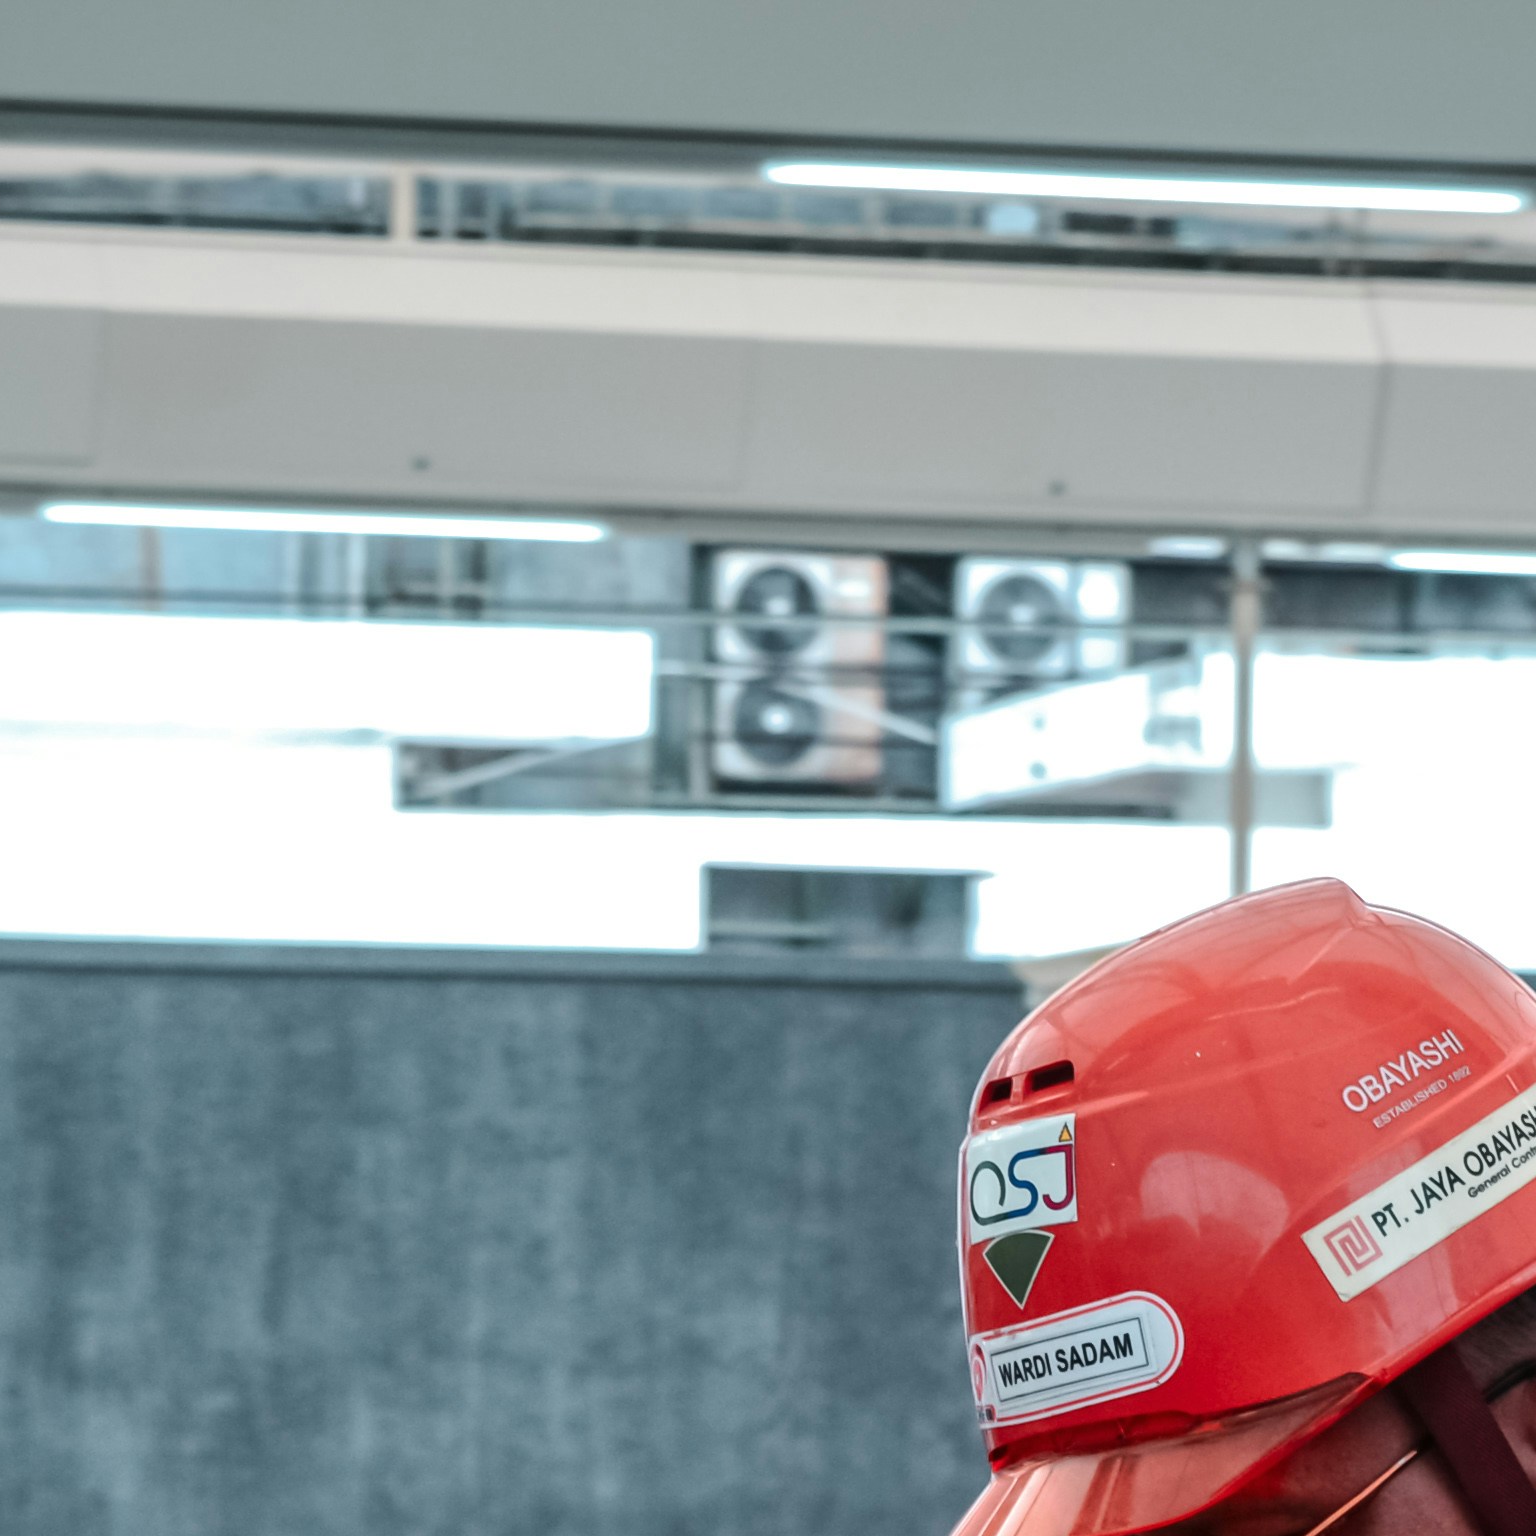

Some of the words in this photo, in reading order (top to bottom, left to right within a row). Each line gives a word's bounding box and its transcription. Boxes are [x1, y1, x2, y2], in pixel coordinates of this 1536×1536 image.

[1342, 1029, 1464, 1113] OBAYASHI
[1372, 1079, 1448, 1129] ESTABLISHED
[1371, 1202, 1409, 1237] PT.
[1410, 1166, 1466, 1214] JAYA
[1468, 1164, 1511, 1198] General
[998, 1353, 1052, 1387] WARDI
[1055, 1333, 1134, 1373] SADAM
